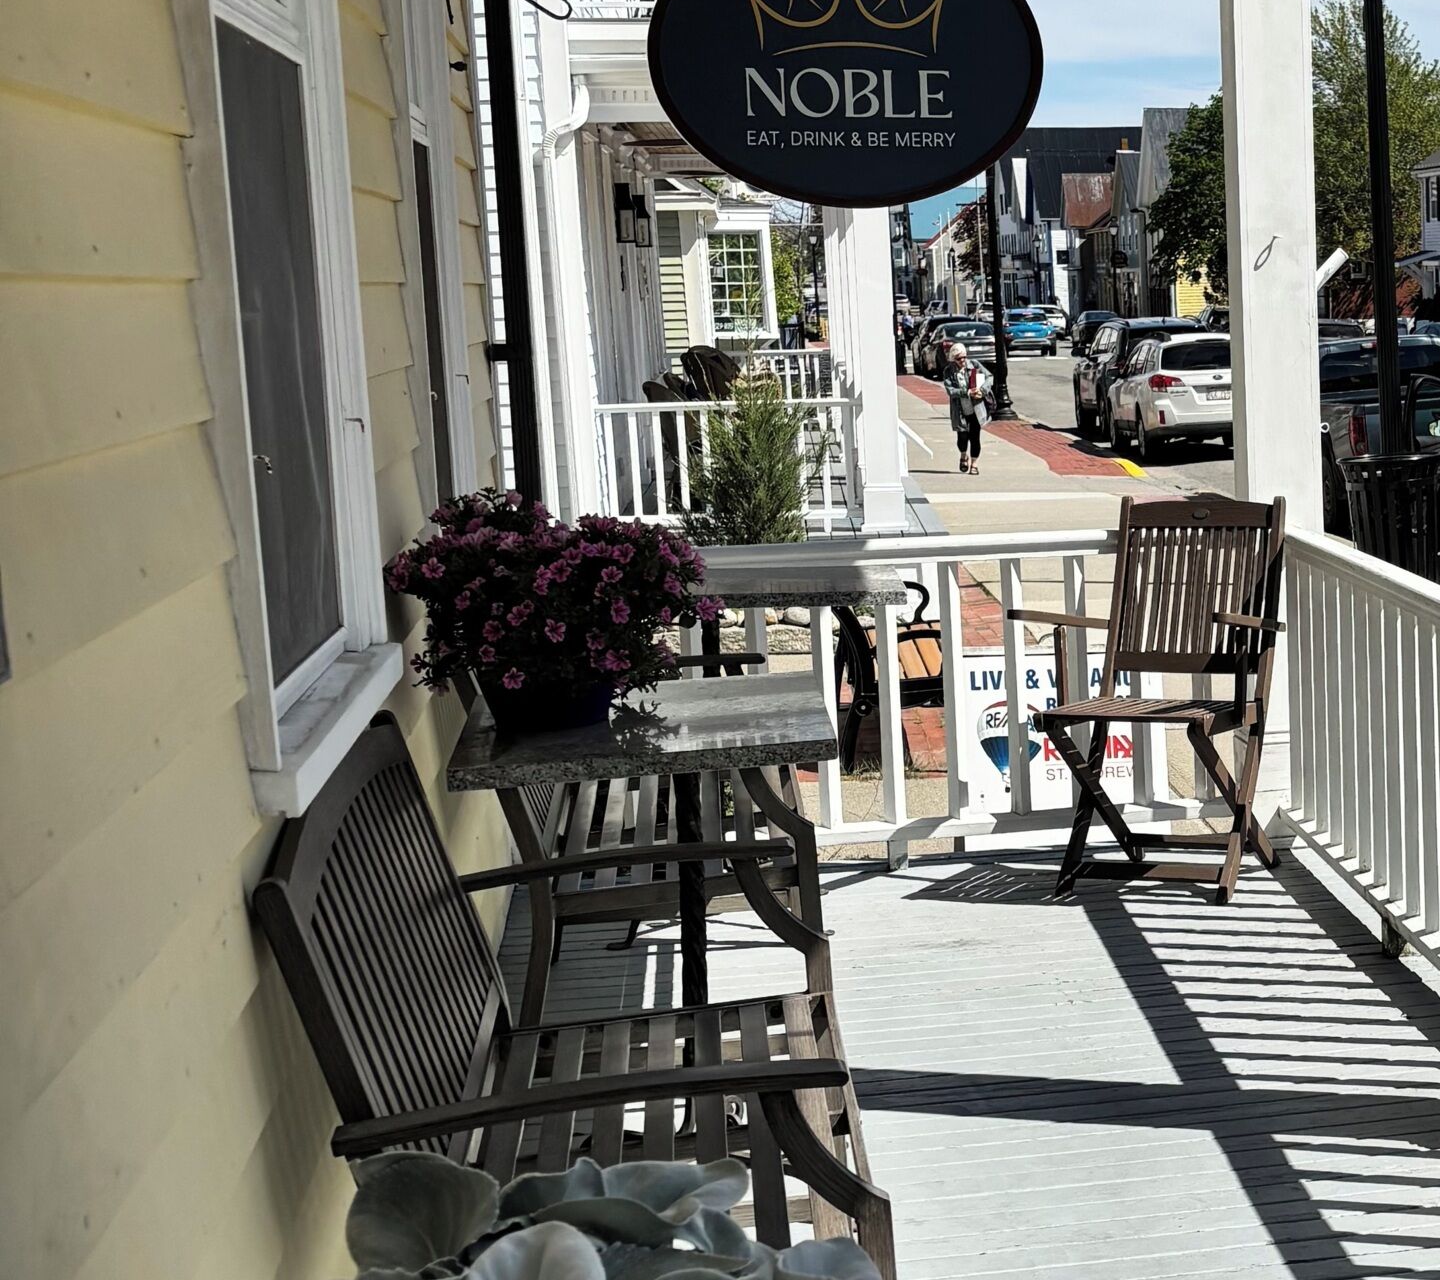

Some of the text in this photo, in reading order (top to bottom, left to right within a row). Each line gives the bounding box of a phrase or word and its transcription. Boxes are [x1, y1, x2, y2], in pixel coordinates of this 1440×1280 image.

[745, 67, 953, 119] NOBLE
[746, 130, 956, 149] EAT, DRINK & BE MERRY
[970, 670, 1003, 691] LIV
[1026, 669, 1040, 689] &
[1046, 768, 1068, 781] ST.
